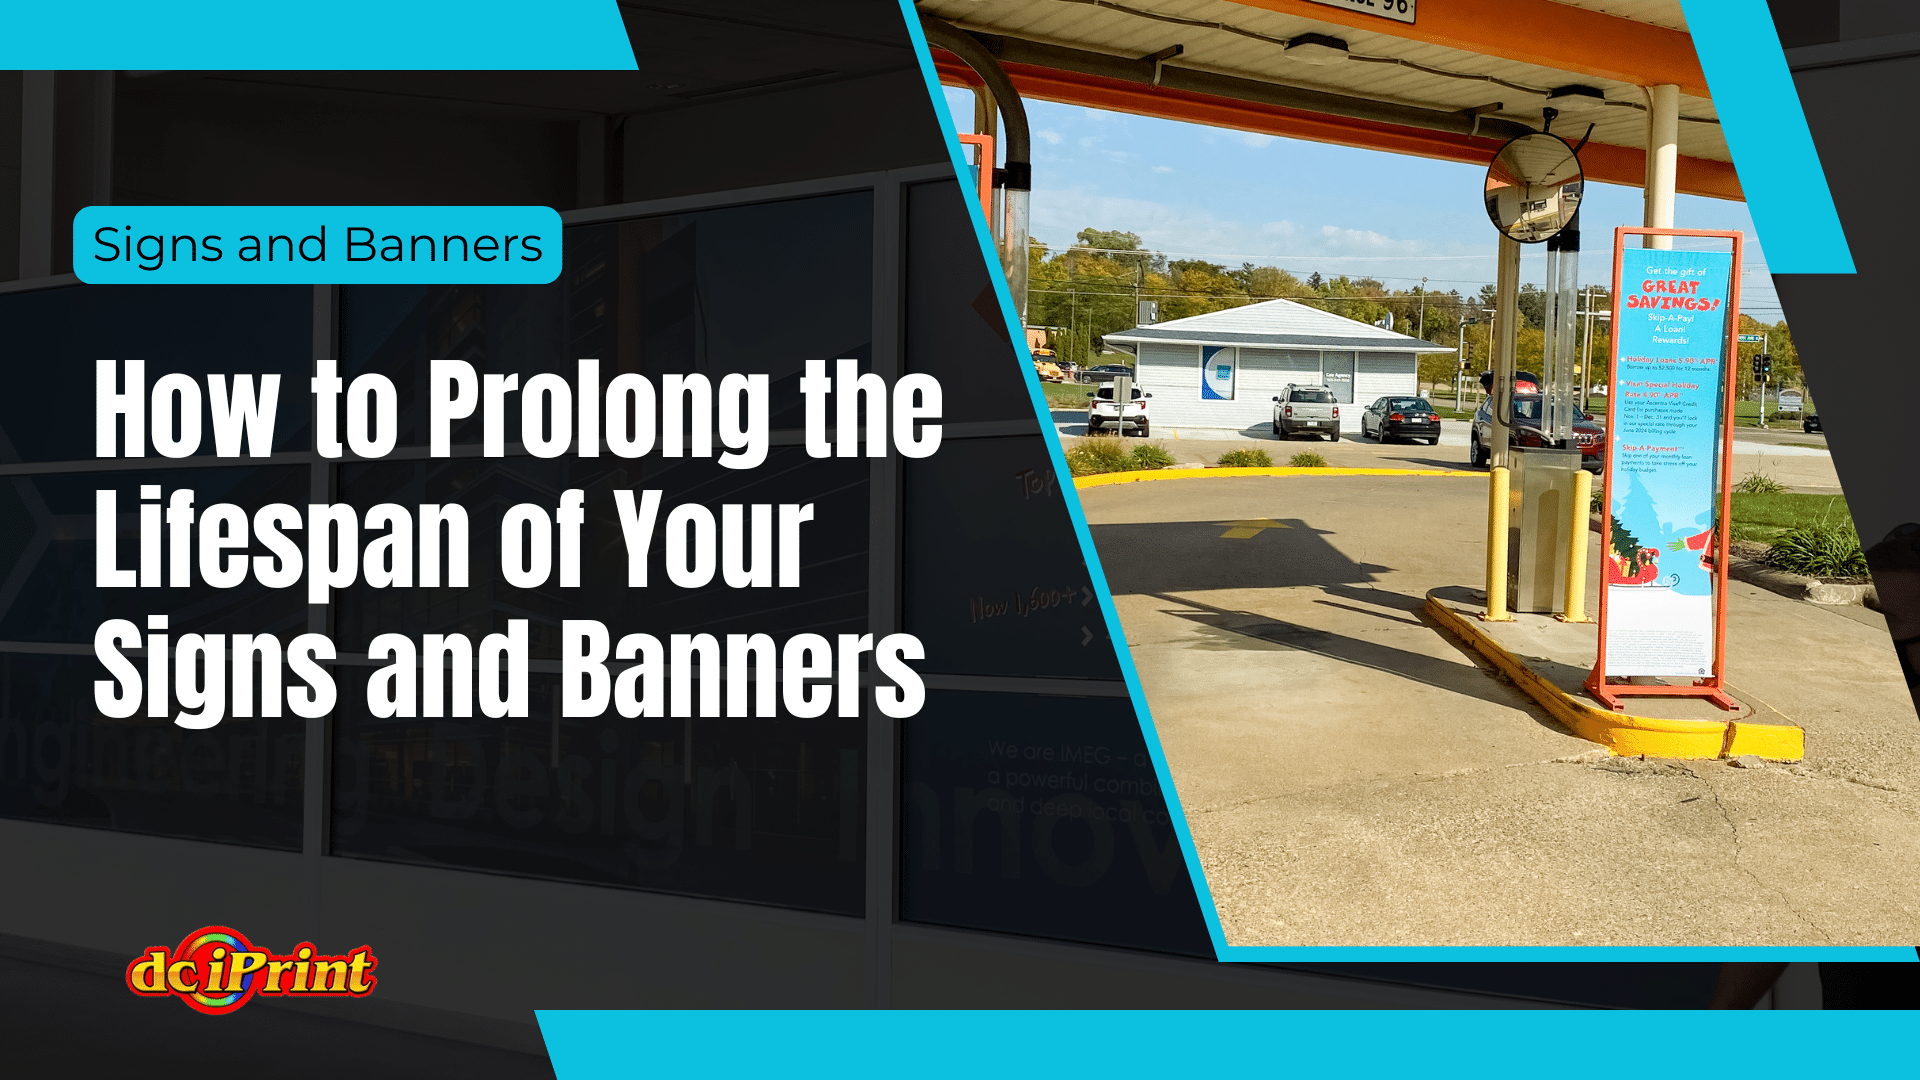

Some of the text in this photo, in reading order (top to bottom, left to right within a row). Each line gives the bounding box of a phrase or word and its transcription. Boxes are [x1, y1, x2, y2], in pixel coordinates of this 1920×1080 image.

[1646, 266, 1707, 277] Get the gift of
[1642, 279, 1701, 294] GREAT
[1626, 294, 1721, 312] SAVINGS!
[1647, 313, 1695, 324] Skip-A-Pay!
[1663, 325, 1686, 333] Loan!
[1652, 336, 1689, 345] Rewards!
[1626, 355, 1654, 364] Holiday
[1656, 357, 1677, 365] Loans
[1645, 380, 1670, 389] Special
[1672, 381, 1699, 391] Holiday
[970, 595, 1008, 624] Now
[988, 739, 1018, 758] We
[1024, 746, 1055, 760] are
[1060, 744, 1111, 765] IMEG
[988, 770, 1001, 784] a
[1006, 767, 1088, 793] powerful
[431, 722, 752, 870] Design
[988, 796, 1024, 812] and
[1031, 799, 1083, 822] deep
[1088, 801, 1137, 823] local
